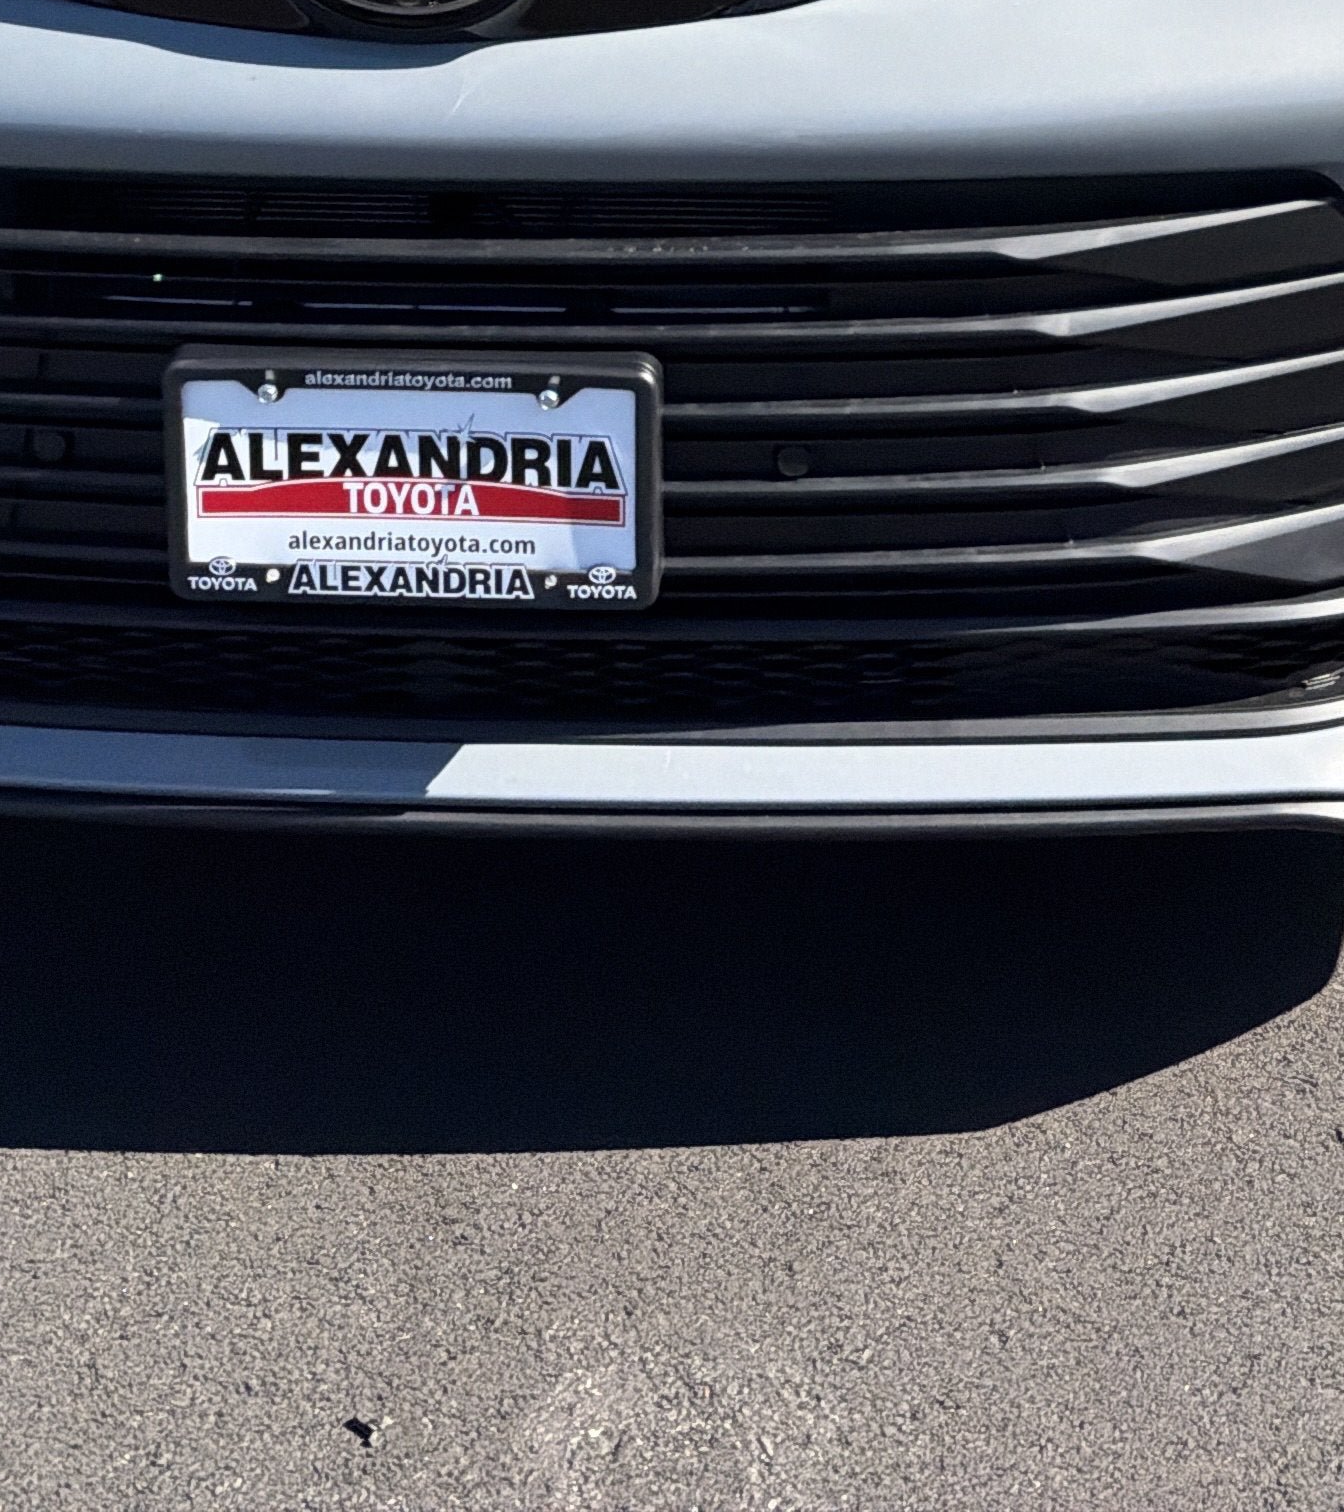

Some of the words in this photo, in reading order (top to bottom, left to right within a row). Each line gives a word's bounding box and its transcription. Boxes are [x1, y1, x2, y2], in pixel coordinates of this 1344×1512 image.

[304, 369, 513, 390] alexandriatoyota.com
[200, 430, 620, 490] ALEXANDRIA
[343, 482, 480, 515] TOYOTA
[288, 530, 536, 557] alexandriatoyota.com
[187, 575, 258, 592] TOYOTA
[291, 561, 533, 598] ALEXANDRIA
[566, 584, 638, 600] TOYOTA
